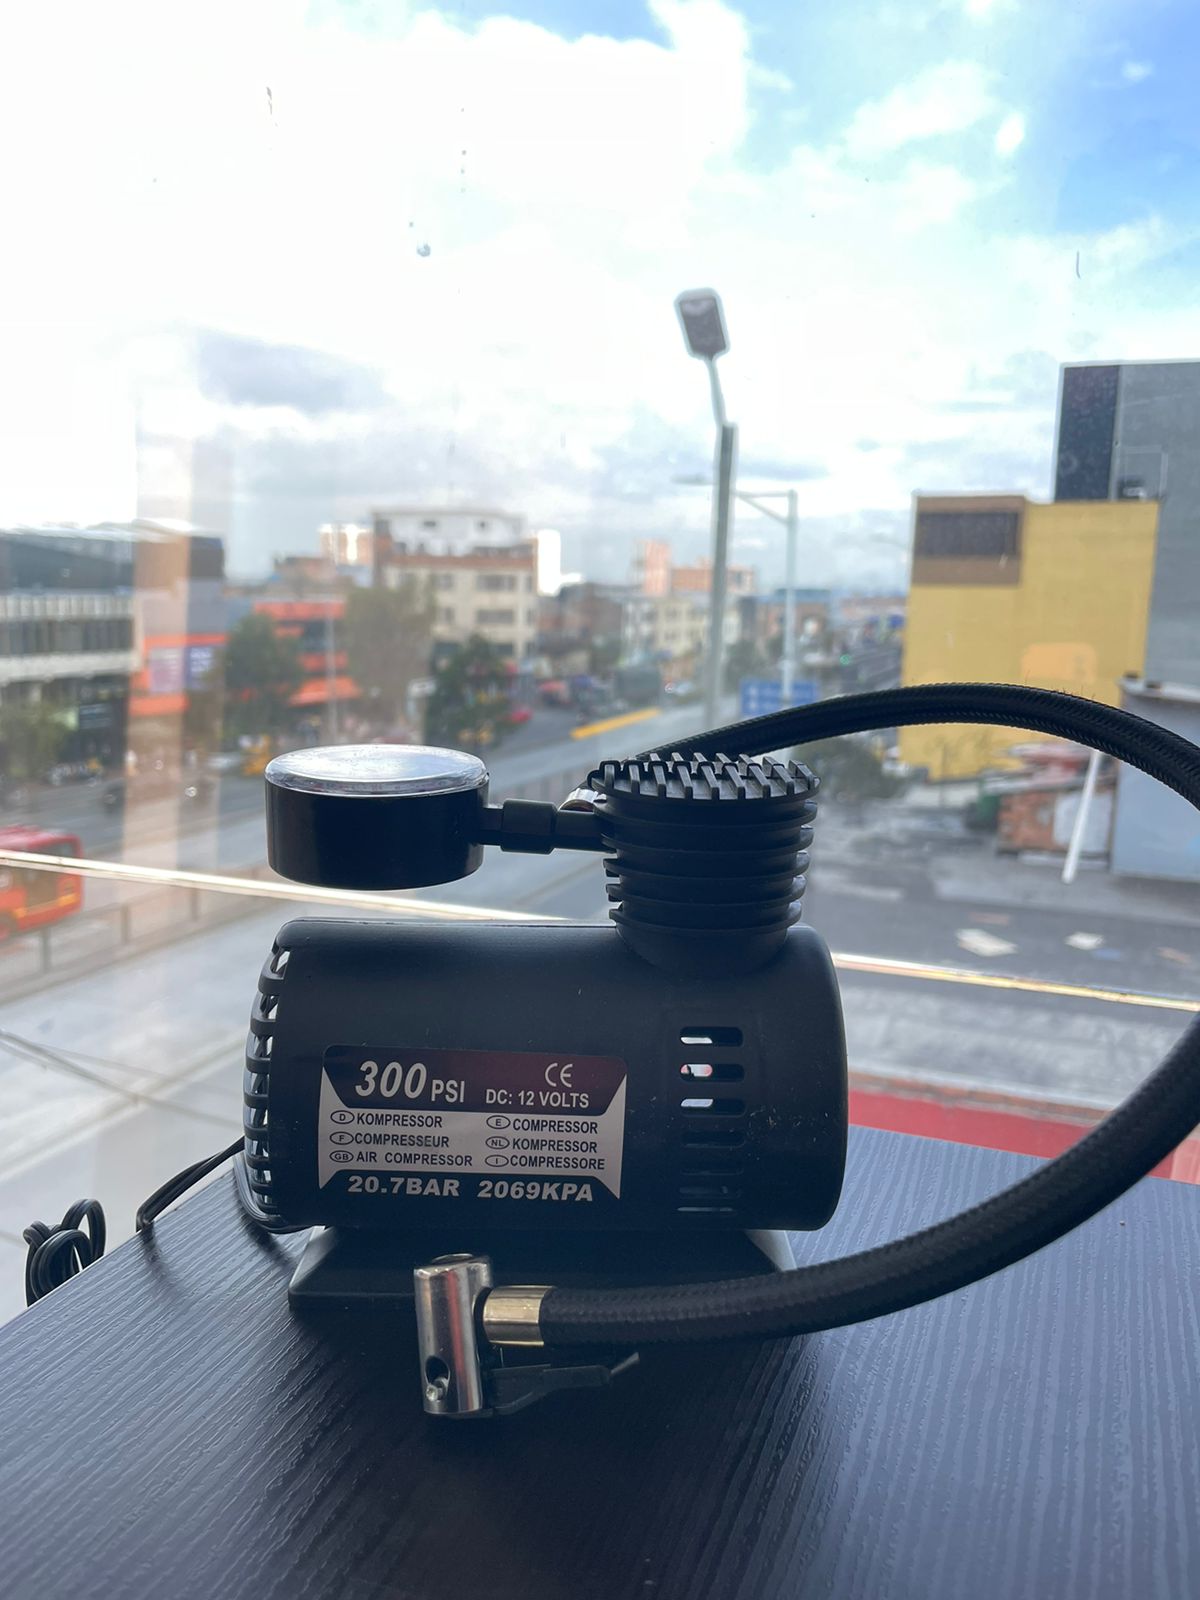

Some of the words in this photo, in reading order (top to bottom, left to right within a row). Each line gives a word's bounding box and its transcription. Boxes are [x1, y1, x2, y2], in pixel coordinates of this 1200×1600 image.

[355, 1060, 427, 1097] 300
[431, 1079, 464, 1103] PSI
[486, 1089, 512, 1105] DC:
[518, 1091, 534, 1106] 12
[539, 1091, 589, 1108] VOLTS
[357, 1112, 442, 1128] KOMPRESSOR
[513, 1118, 598, 1134] COMPRESSOR
[355, 1133, 449, 1148] COMPRESSEUR
[513, 1138, 597, 1153] KOMPRESSOR
[357, 1151, 377, 1163] AIR
[385, 1152, 472, 1167] COMPRESSOR
[510, 1155, 605, 1170] COMPRESSORE
[348, 1175, 460, 1197] 20.7BAR
[478, 1180, 593, 1202] 2069KPA
